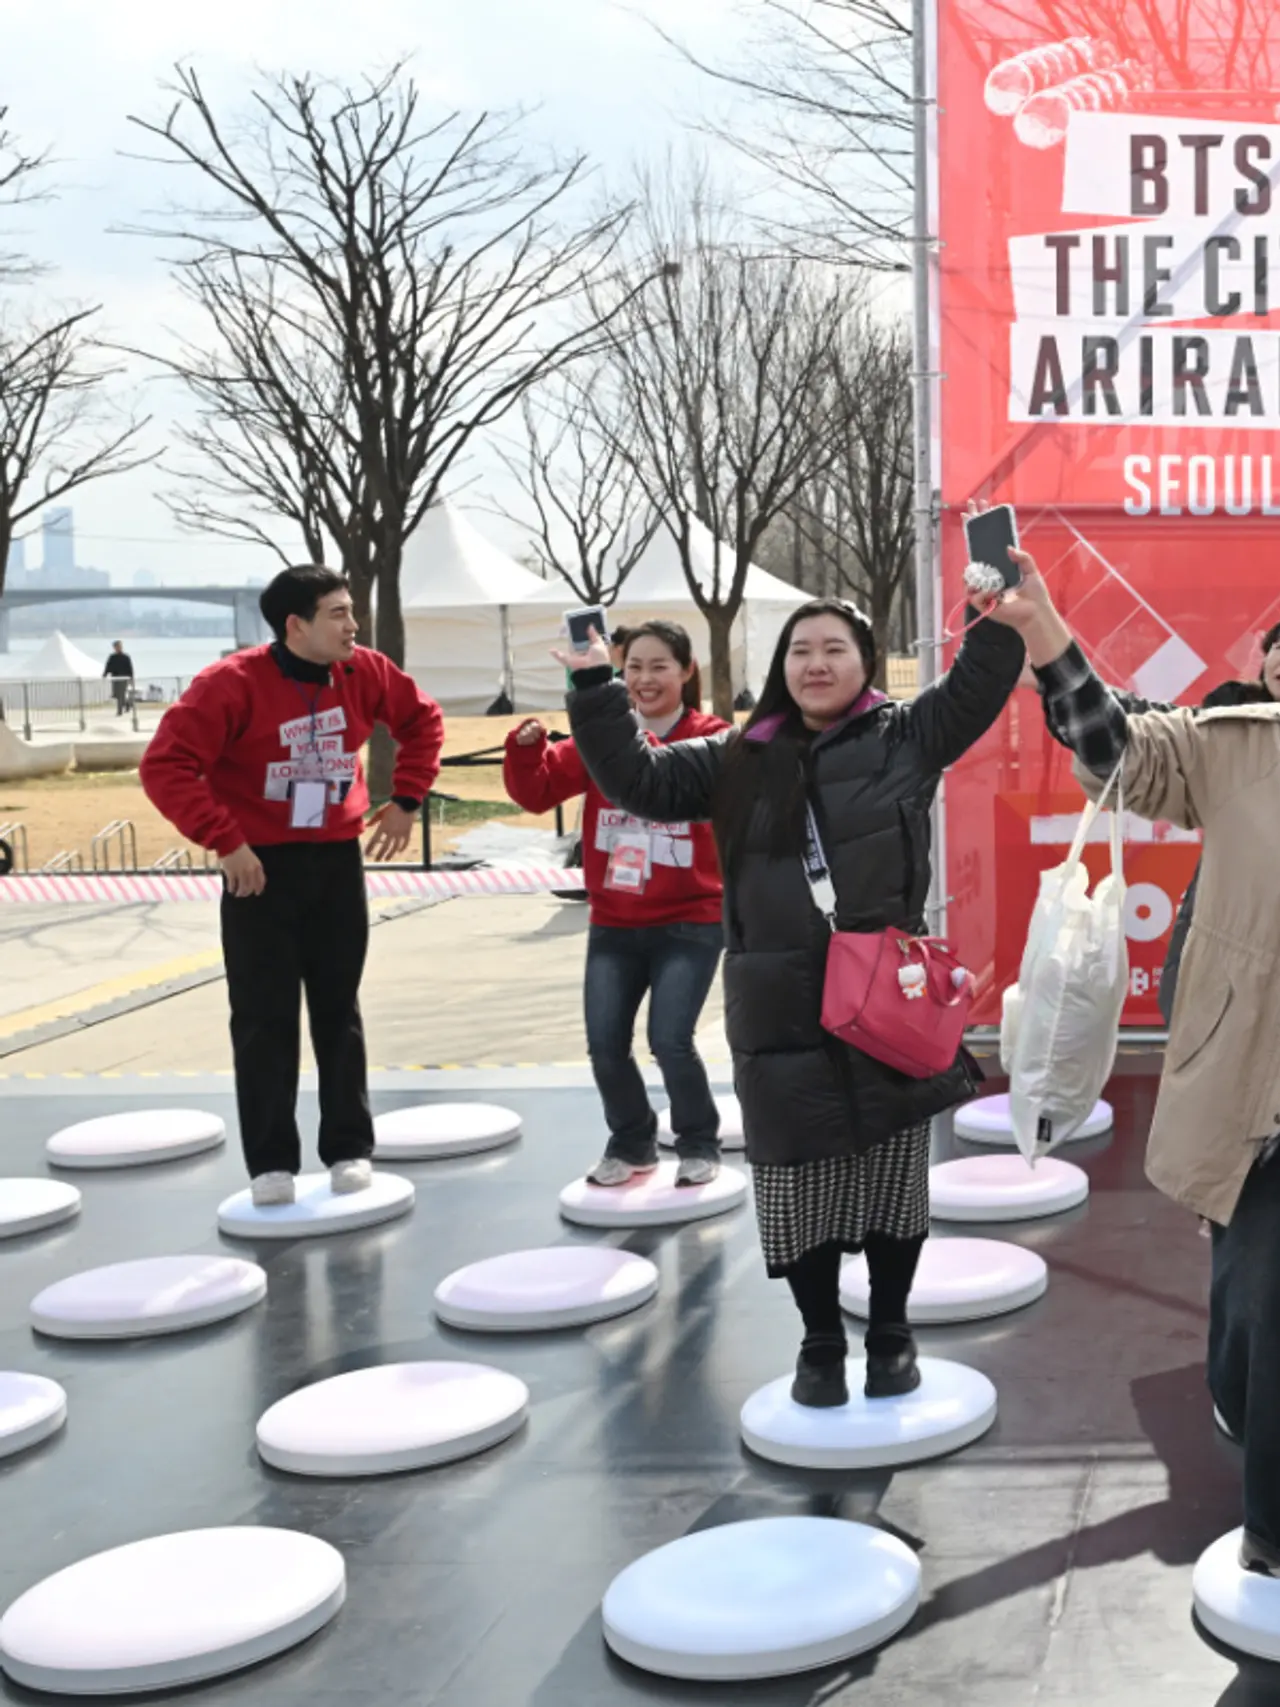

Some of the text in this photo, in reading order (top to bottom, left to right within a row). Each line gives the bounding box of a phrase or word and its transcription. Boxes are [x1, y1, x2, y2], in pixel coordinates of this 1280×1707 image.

[1128, 133, 1273, 218] BTS
[1044, 233, 1175, 318] THE
[296, 739, 338, 753] YOUR
